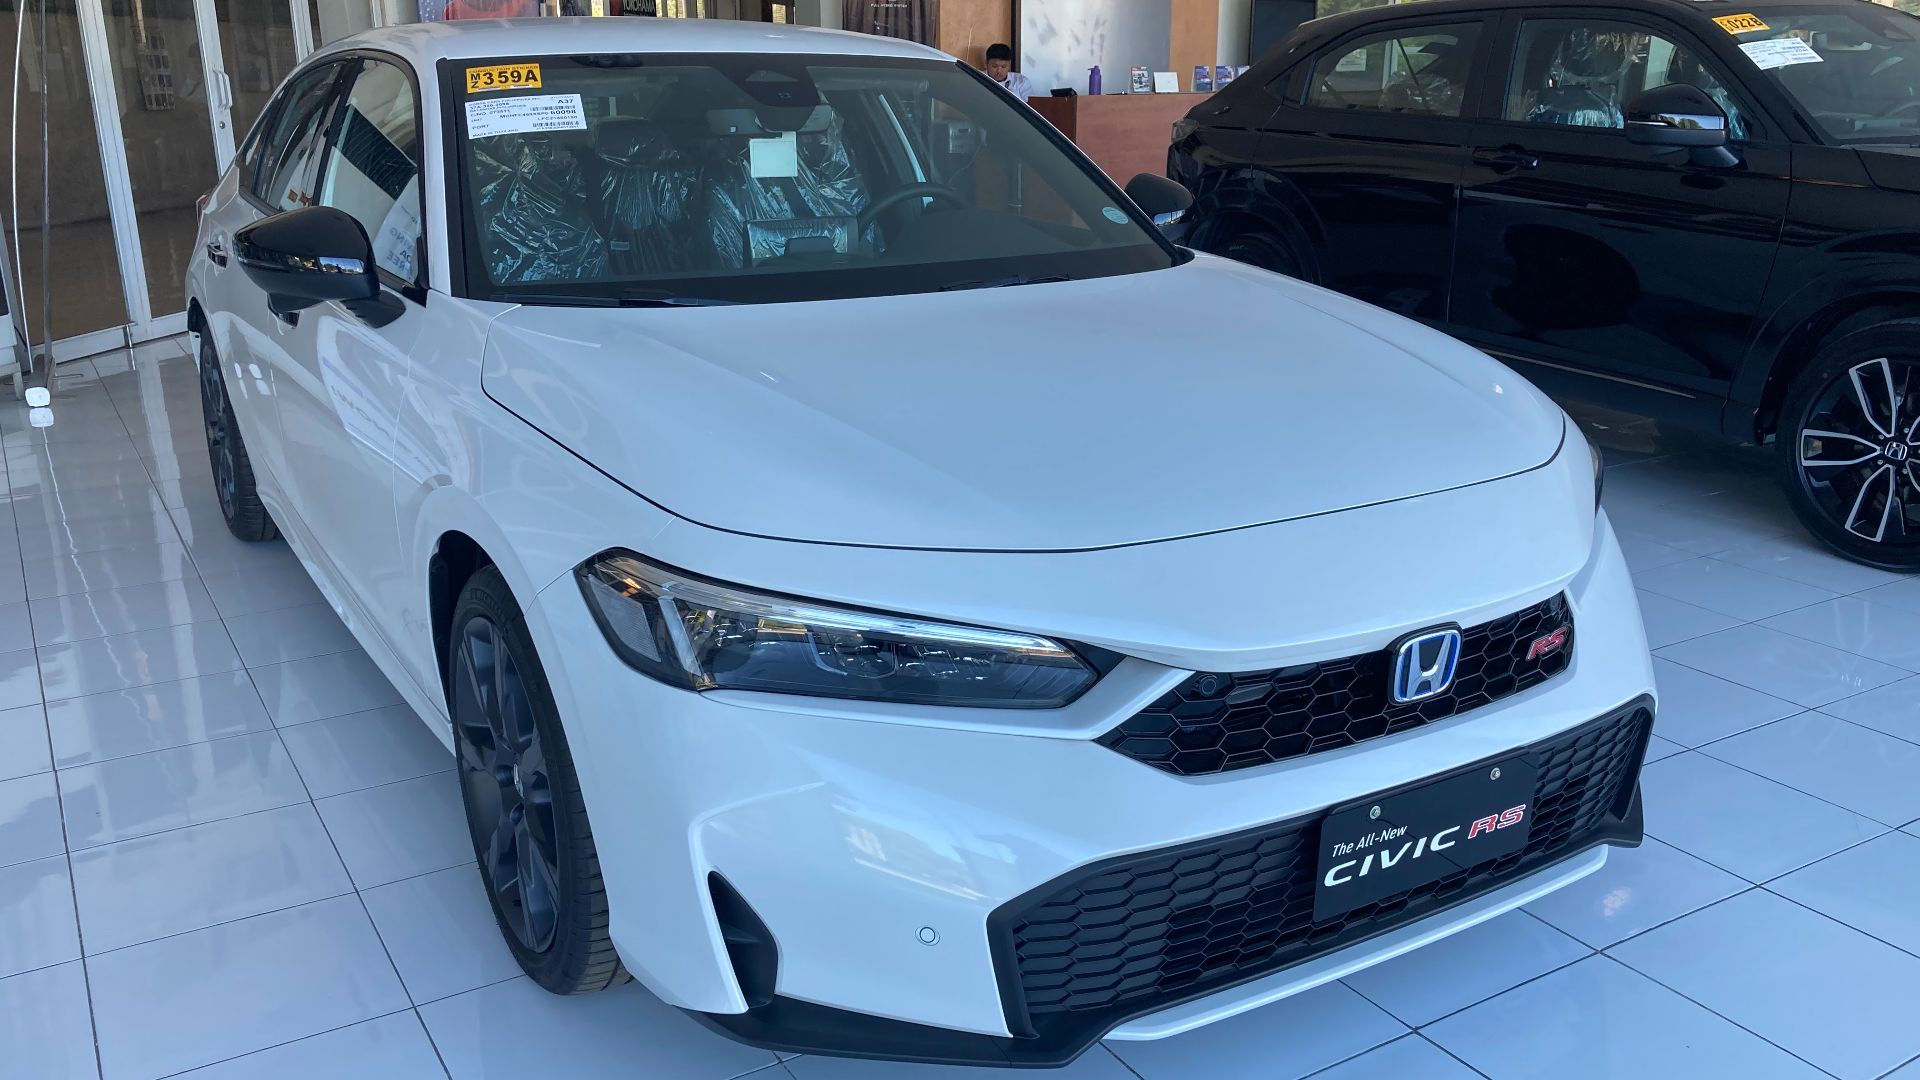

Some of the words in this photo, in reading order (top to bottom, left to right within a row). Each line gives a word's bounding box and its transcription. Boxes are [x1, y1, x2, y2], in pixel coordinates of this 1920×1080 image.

[482, 69, 539, 86] 359A
[1526, 625, 1570, 662] RS
[1324, 825, 1461, 887] CIVIC
[1467, 804, 1527, 840] RS
[1332, 840, 1354, 858] The
[1356, 825, 1408, 851] All-New
